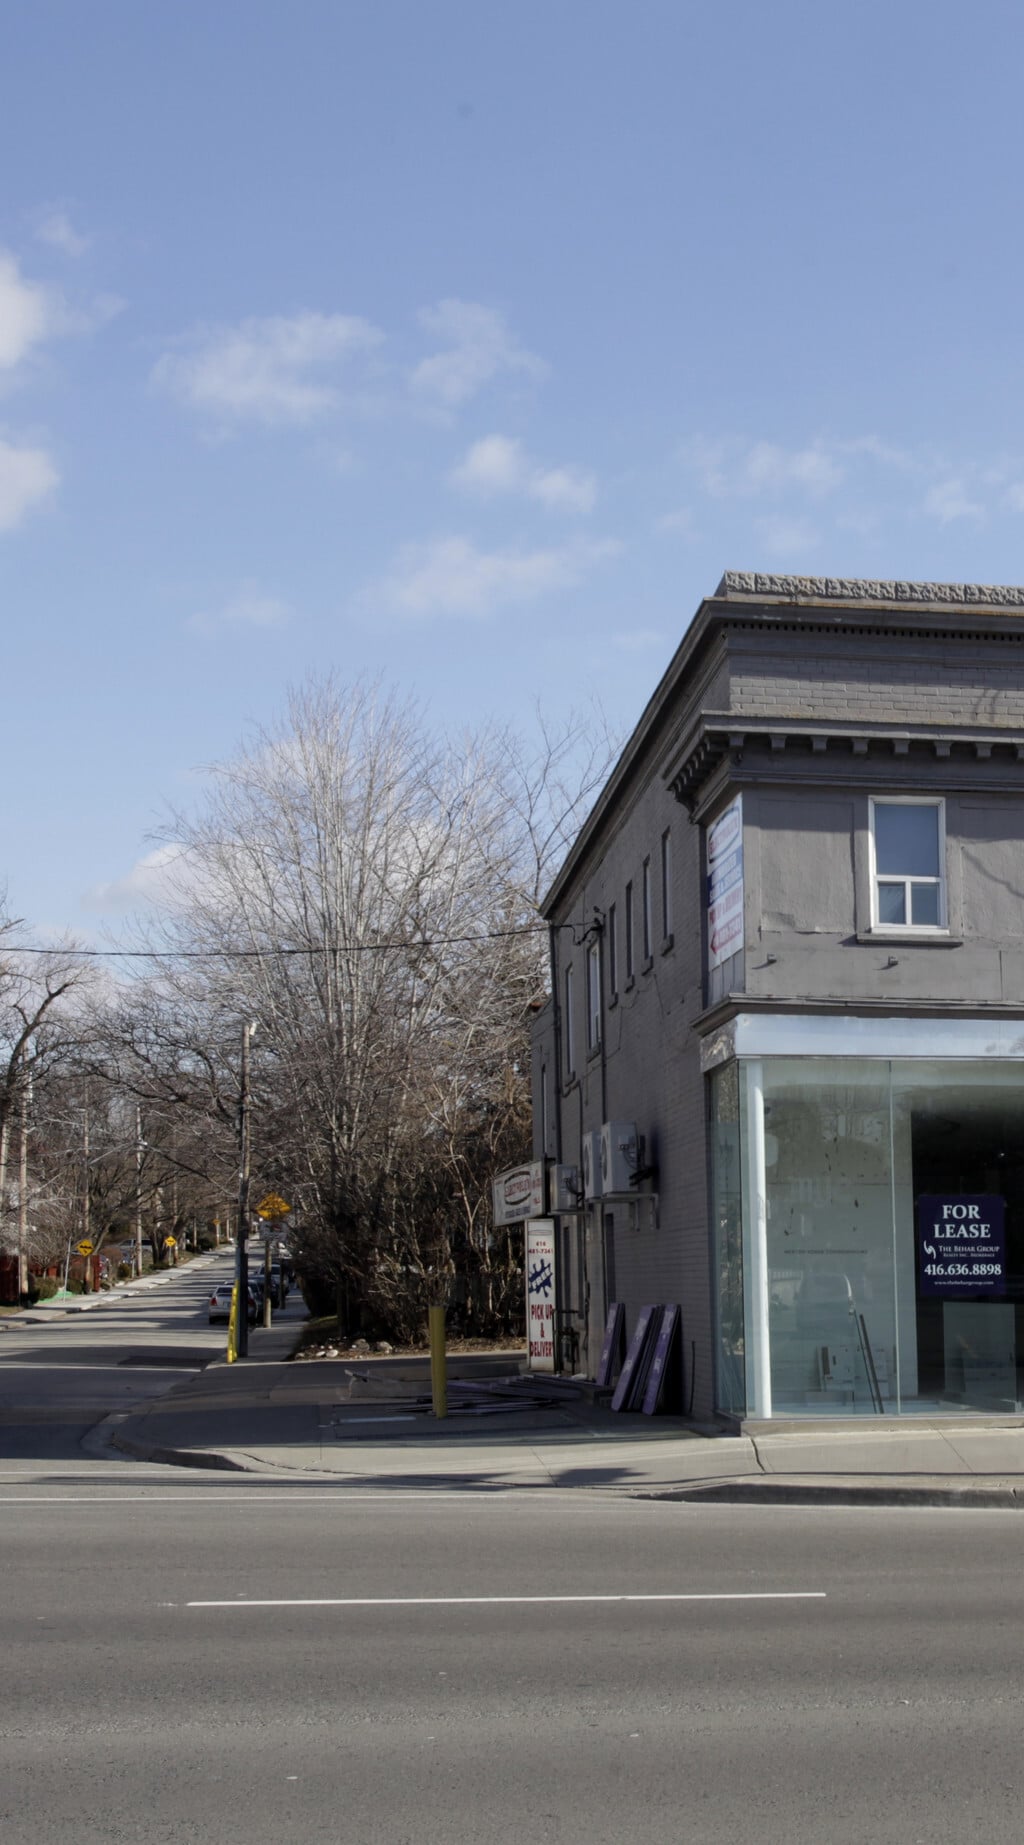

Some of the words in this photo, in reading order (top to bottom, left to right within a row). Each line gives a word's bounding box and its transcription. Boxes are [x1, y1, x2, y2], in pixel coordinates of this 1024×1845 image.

[942, 1204, 981, 1219] FOR
[934, 1223, 991, 1239] LEASE
[954, 1245, 976, 1253] BEHAR
[976, 1245, 1000, 1253] GROUP
[924, 1263, 1002, 1276] 416.636.8898
[531, 1304, 544, 1320] PICK
[529, 1341, 553, 1357] DELIVER
